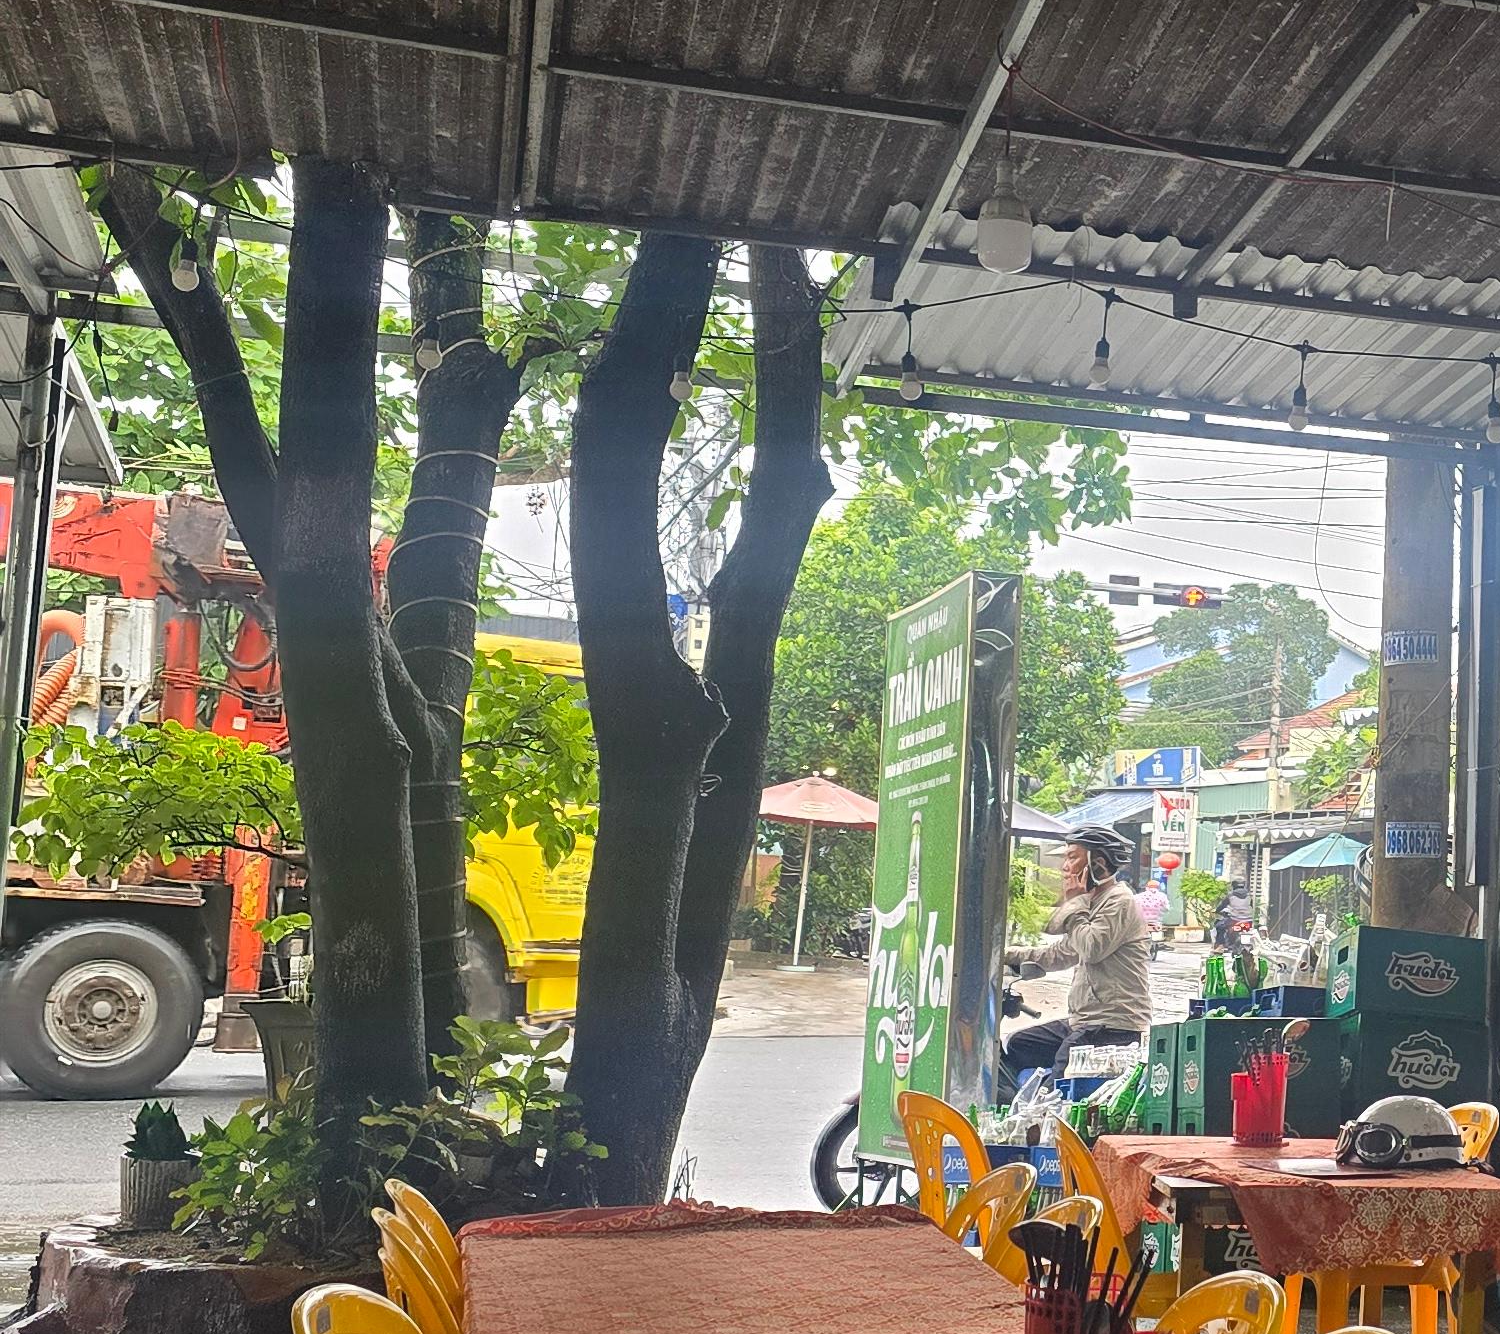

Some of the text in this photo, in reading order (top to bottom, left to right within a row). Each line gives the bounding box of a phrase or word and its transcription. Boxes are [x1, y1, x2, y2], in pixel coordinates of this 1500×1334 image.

[888, 643, 963, 728] TRẦN OANH
[1387, 952, 1458, 984] huda
[1390, 1049, 1458, 1079] huda
